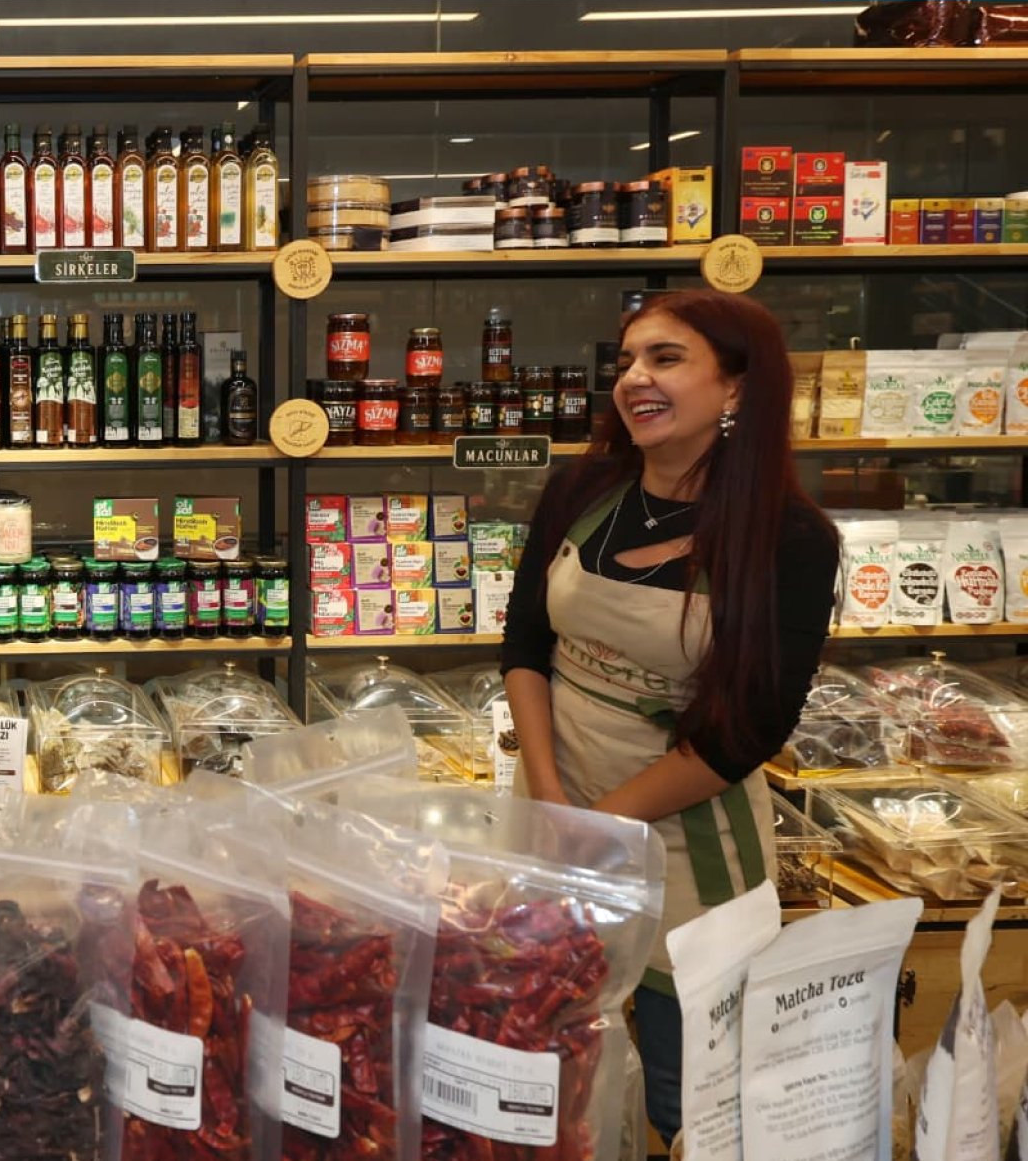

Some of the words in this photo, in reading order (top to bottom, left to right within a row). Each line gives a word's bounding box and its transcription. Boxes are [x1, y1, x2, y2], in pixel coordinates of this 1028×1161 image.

[55, 260, 118, 276] SİRKELER
[465, 449, 540, 462] MACUNLAR
[775, 981, 824, 1014] Matcha
